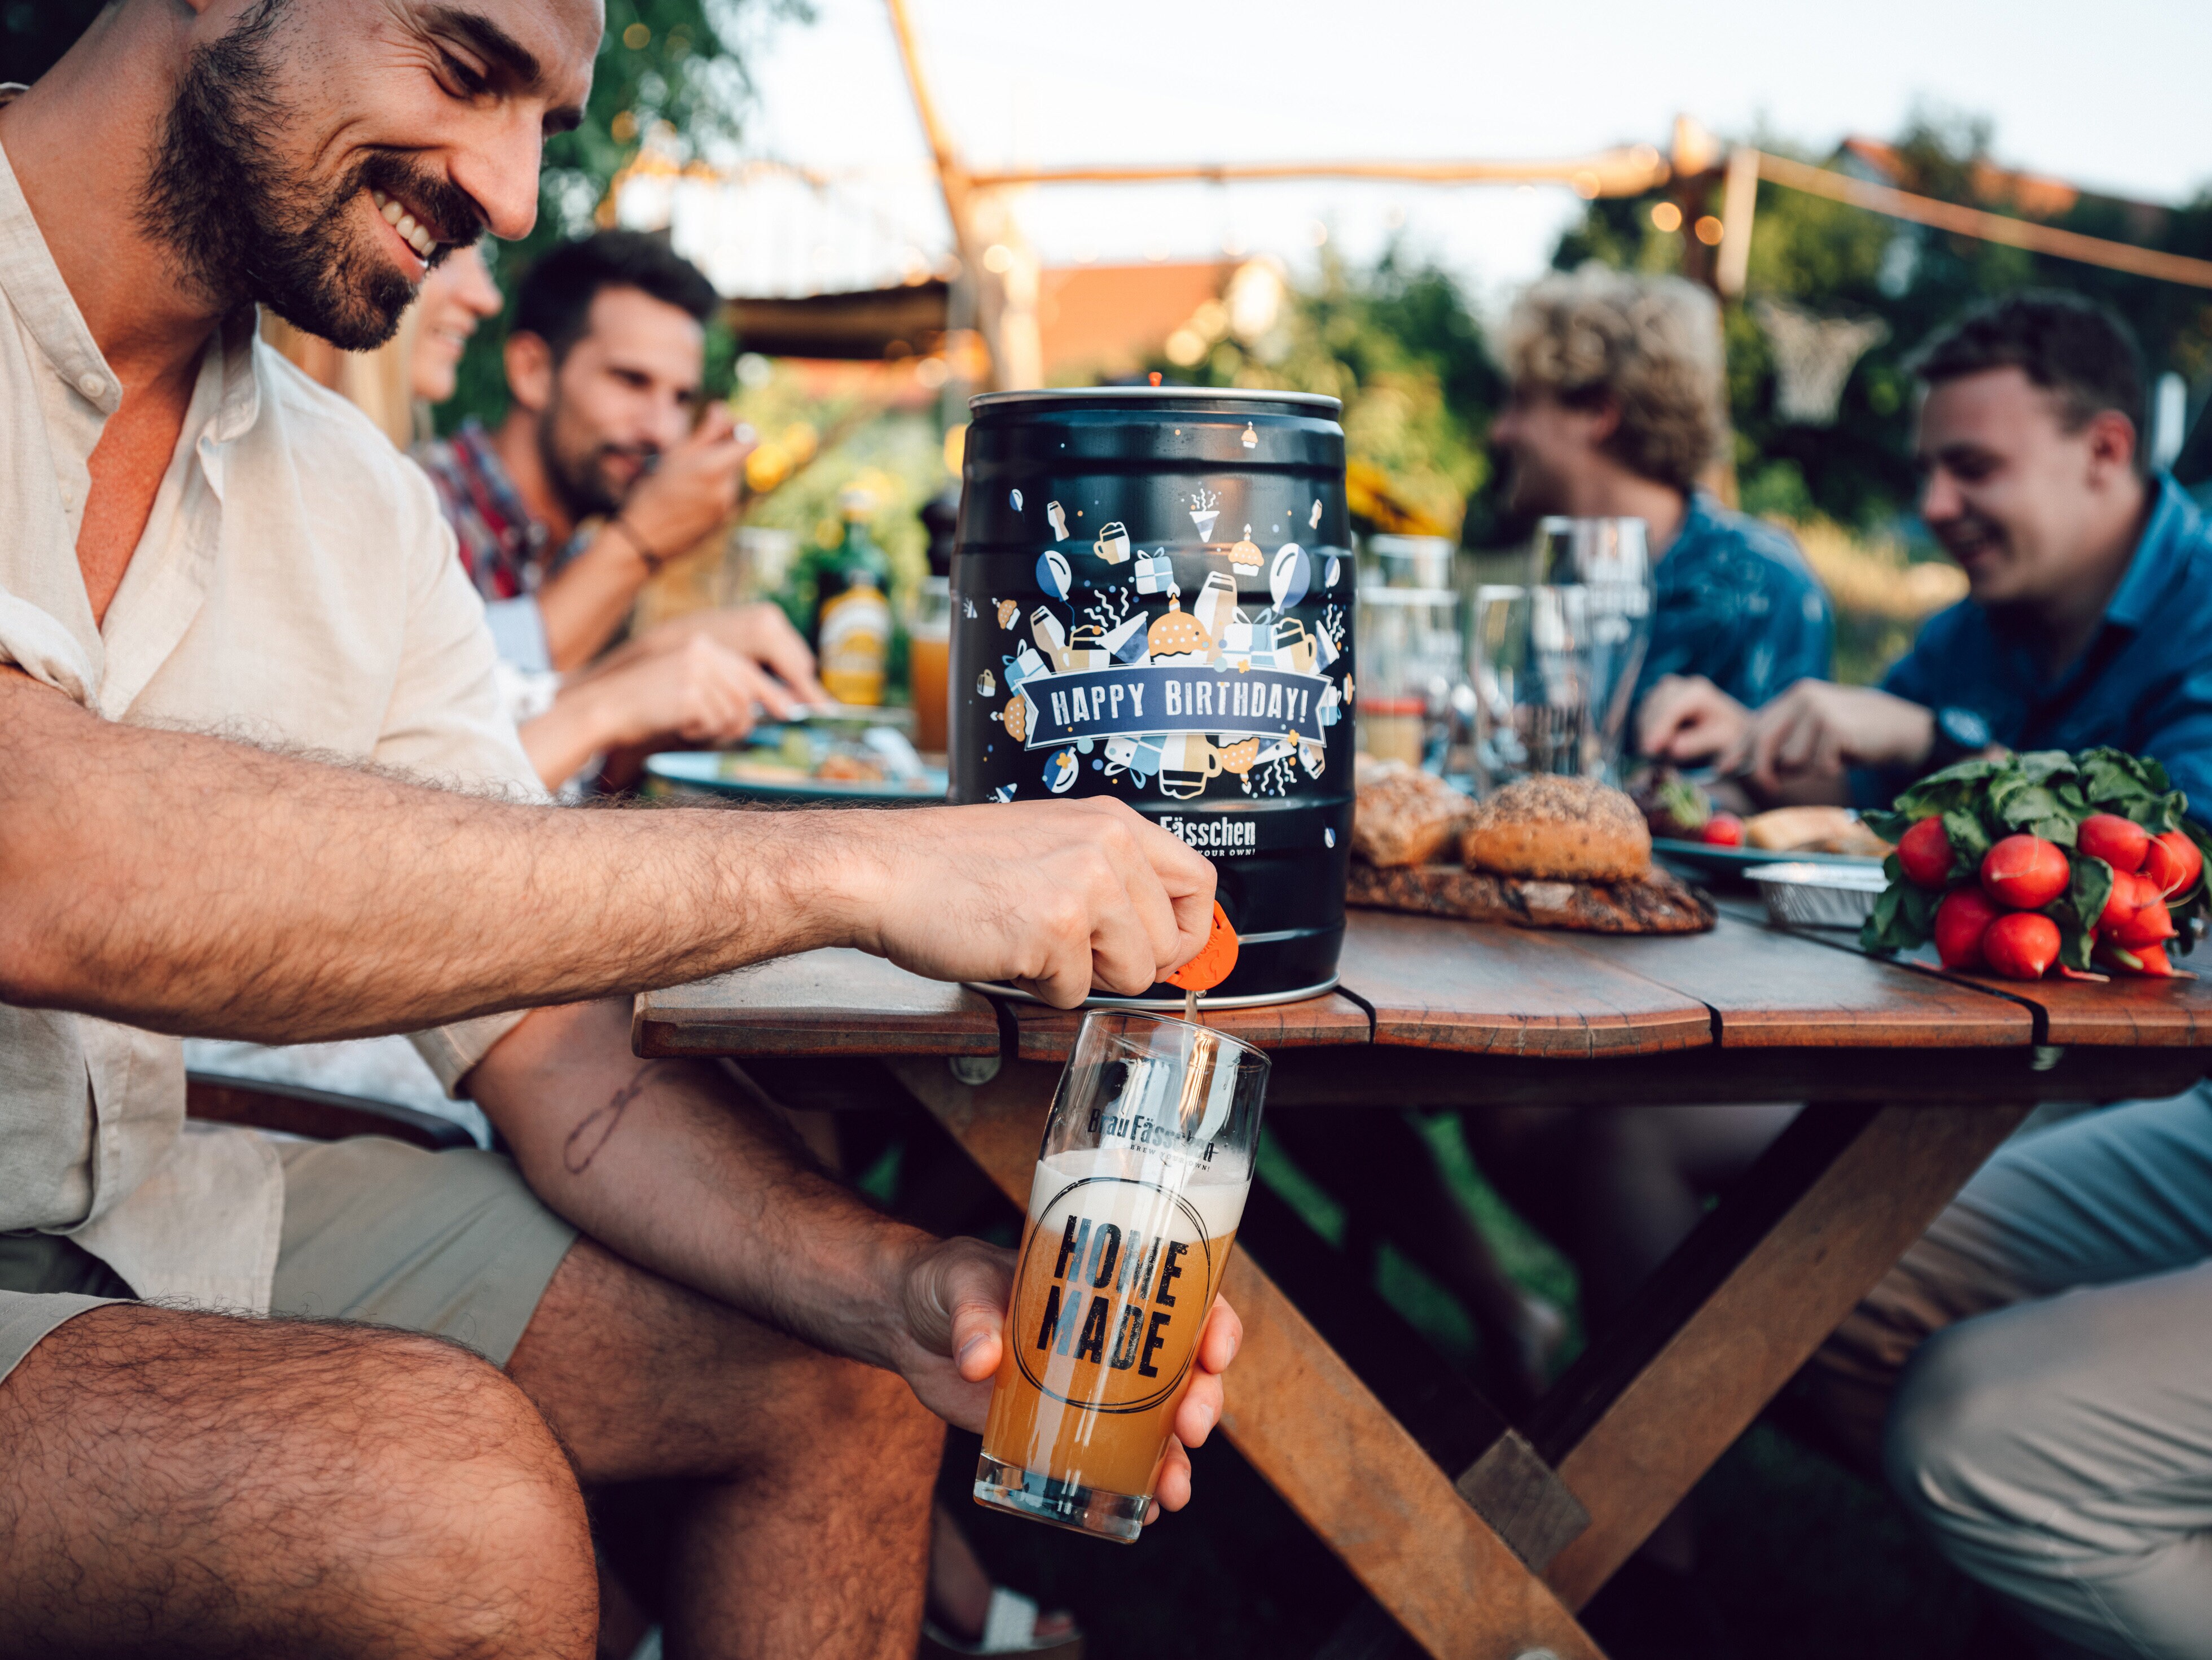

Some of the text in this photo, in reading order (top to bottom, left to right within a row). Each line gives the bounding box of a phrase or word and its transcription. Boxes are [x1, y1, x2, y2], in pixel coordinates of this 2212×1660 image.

[1051, 680, 1309, 726] HAPPY BIRTHDAY!
[1130, 1144, 1210, 1172] BREW YOUR OWN!
[1054, 1214, 1190, 1308] HOME
[1036, 1285, 1172, 1379] MADE
